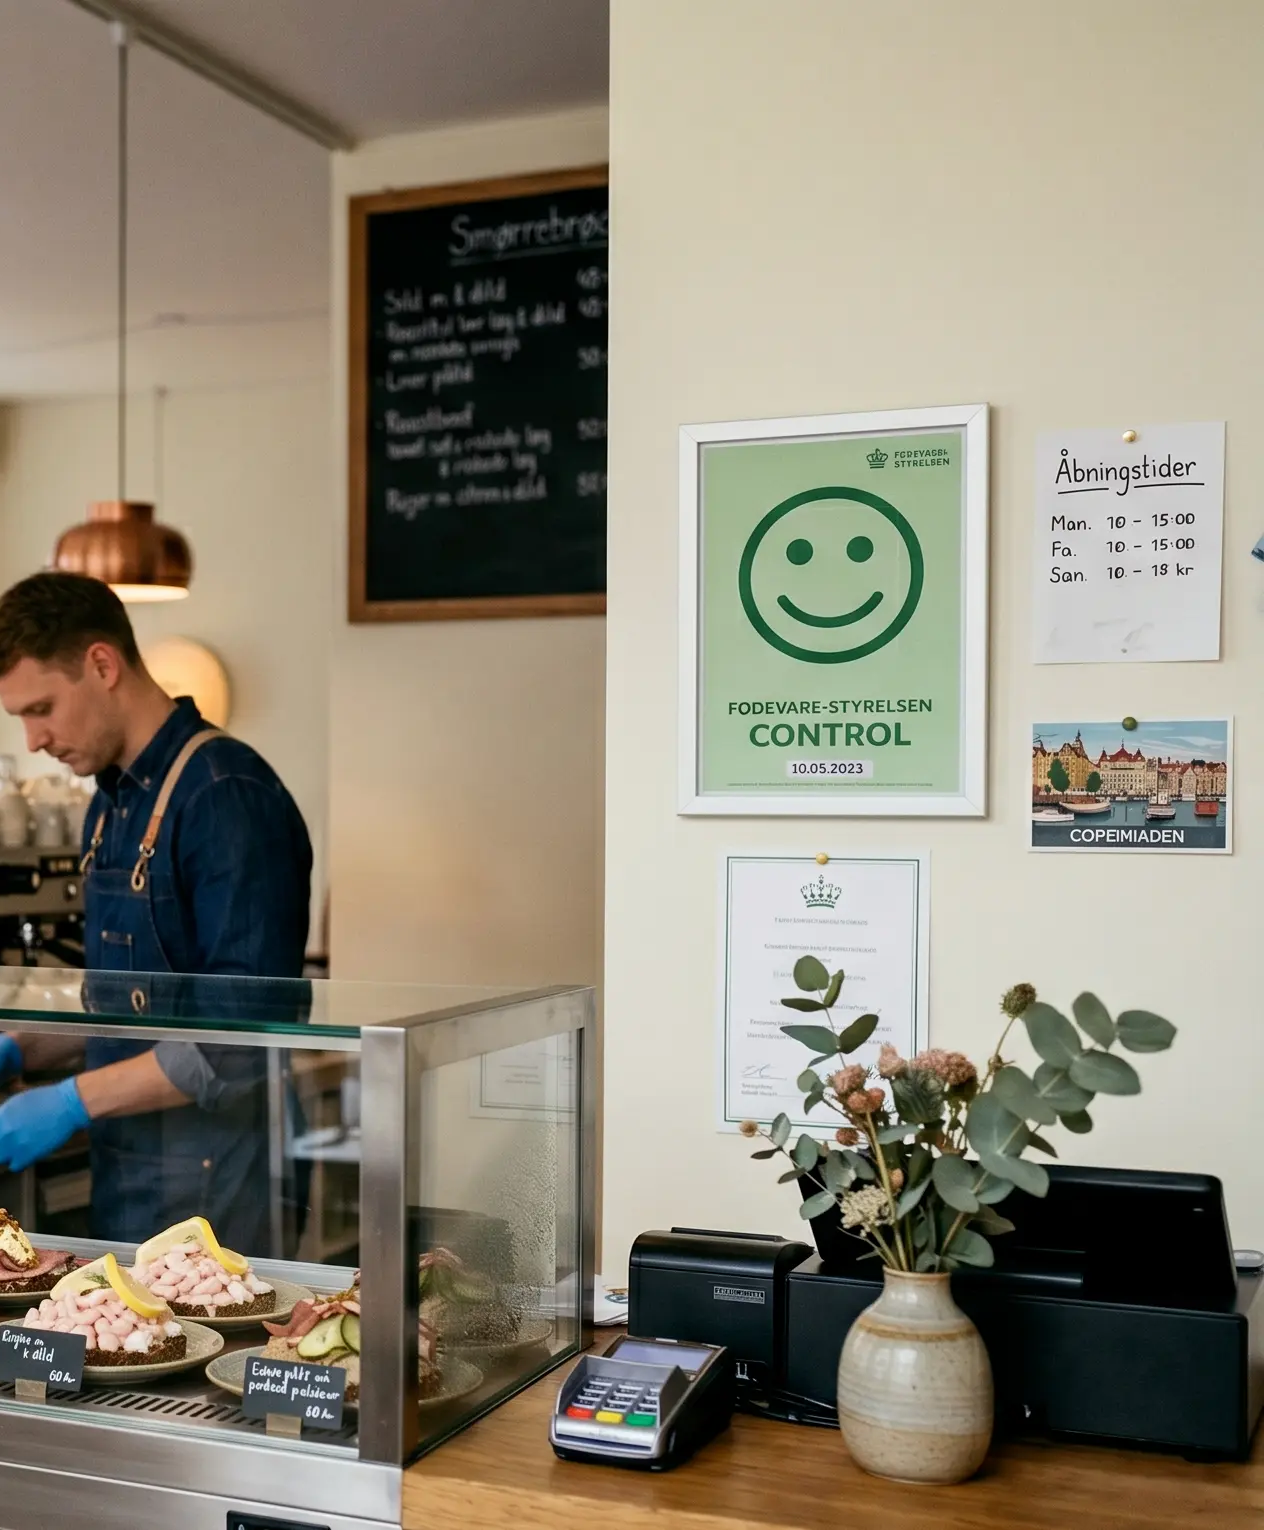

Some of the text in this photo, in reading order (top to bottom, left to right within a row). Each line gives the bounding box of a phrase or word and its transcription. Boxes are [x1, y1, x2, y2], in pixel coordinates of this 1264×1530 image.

[1055, 448, 1197, 496] Åbningstider
[1051, 515, 1091, 531] Man.
[1107, 516, 1126, 530] 10
[1151, 513, 1195, 527] 15:00
[1052, 541, 1077, 557] Fa.
[1151, 538, 1195, 552] 15:00
[1049, 566, 1087, 583] San.
[1176, 562, 1194, 576] kr
[728, 698, 932, 715] FODEVARE-STYRELSEN
[749, 722, 912, 748] CONTROL
[792, 763, 864, 774] 10.05.2023
